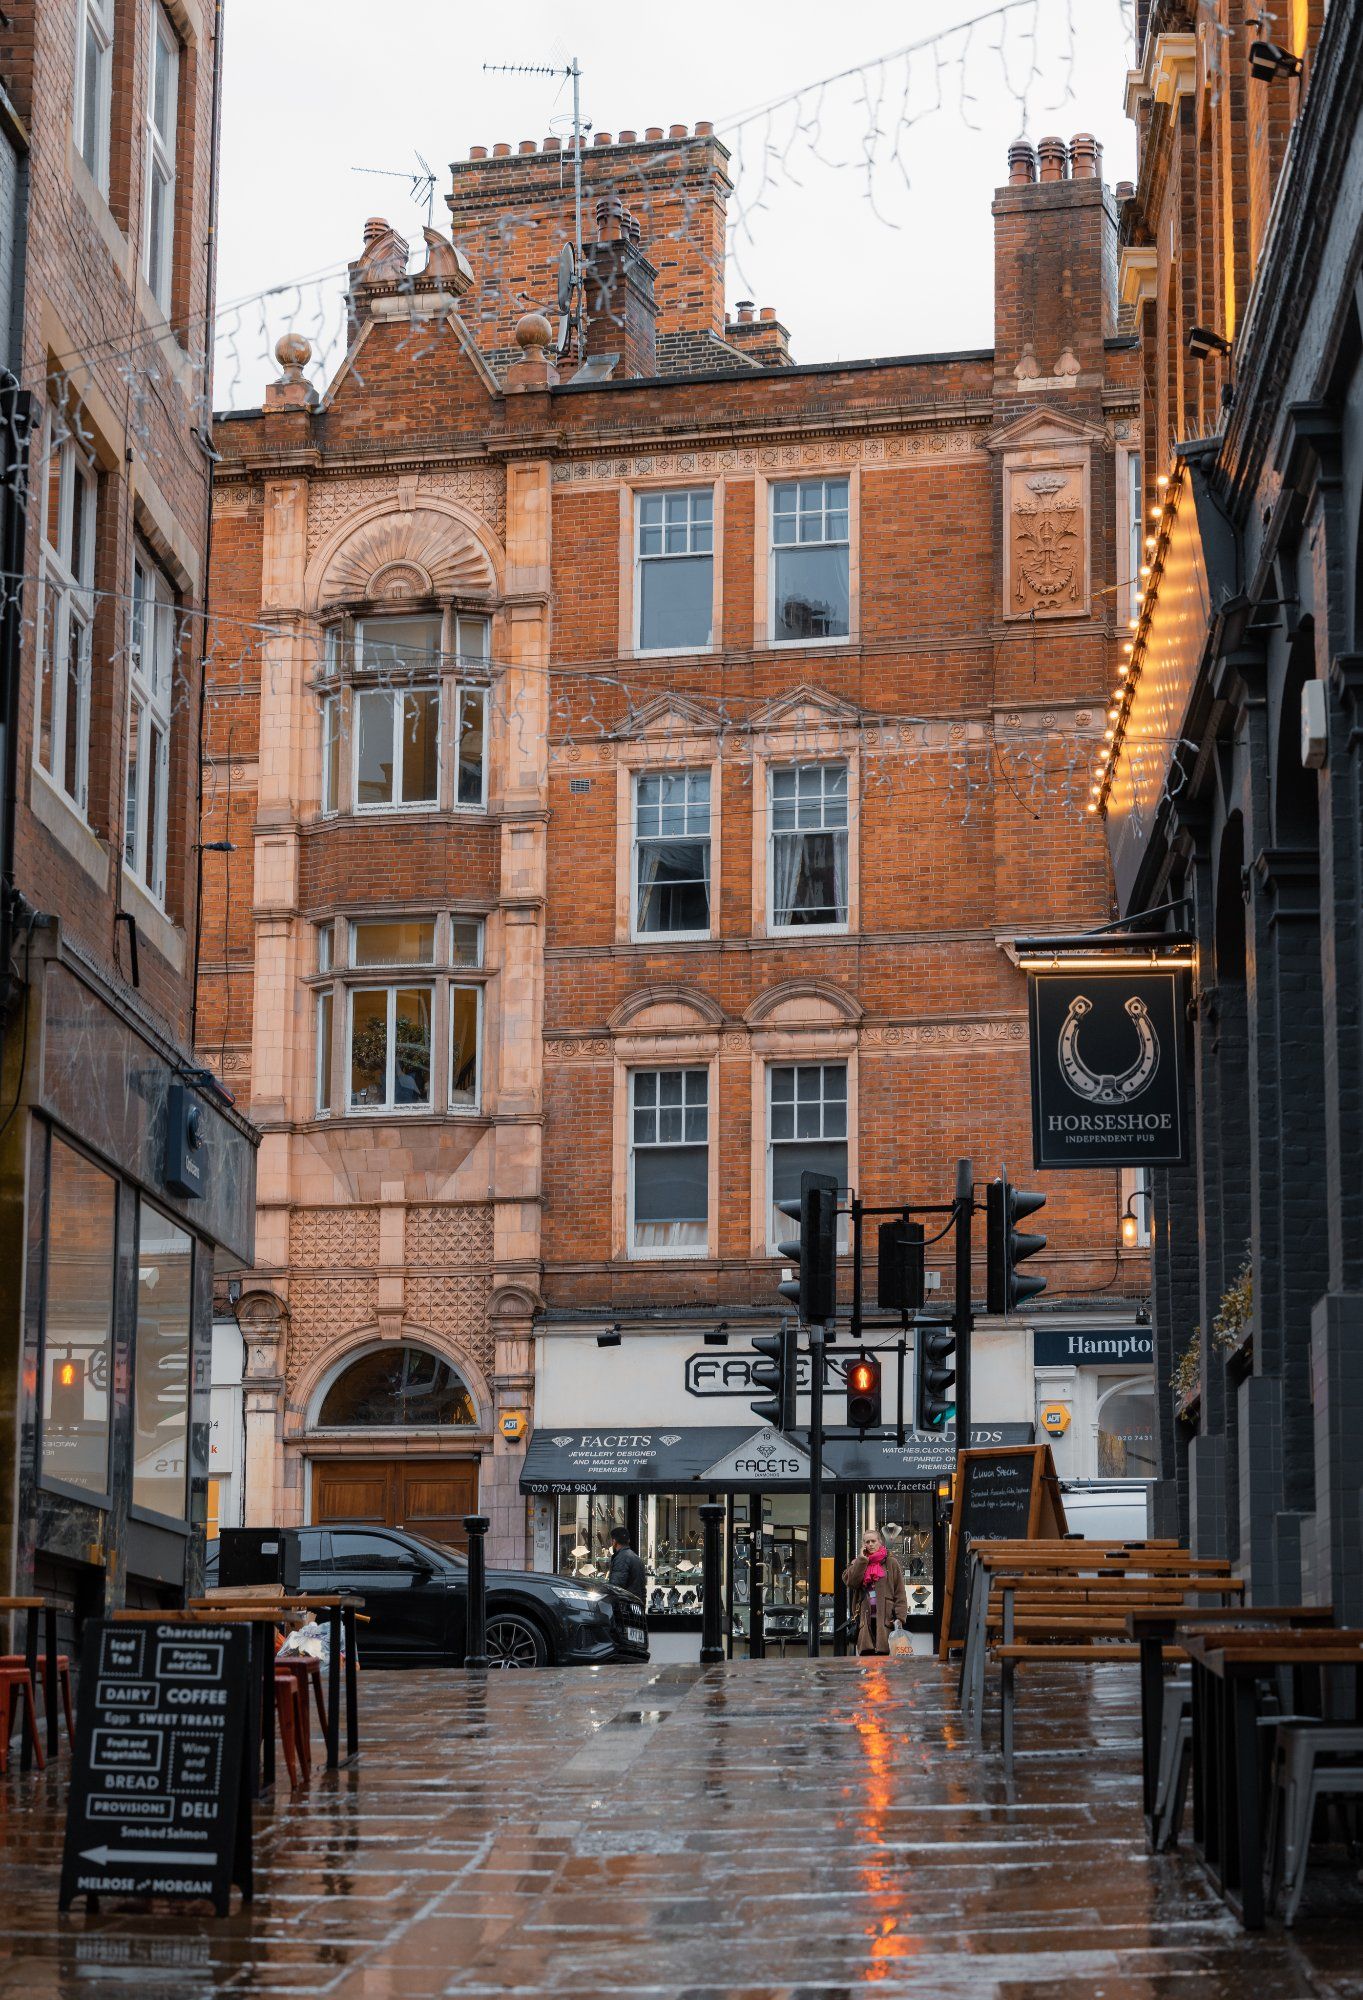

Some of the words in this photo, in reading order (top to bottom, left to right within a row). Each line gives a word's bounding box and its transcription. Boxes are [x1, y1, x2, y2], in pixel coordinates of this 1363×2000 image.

[1048, 1113, 1172, 1131] HORSESHOE
[1065, 1134, 1134, 1144] INDEPENDENT
[1136, 1134, 1155, 1142] PUB
[1067, 1336, 1154, 1358] Hampto
[504, 1420, 517, 1429] ADT
[579, 1435, 652, 1448] FACETS
[762, 1433, 771, 1441] 19
[568, 1450, 615, 1458] JEWELLERY
[735, 1459, 799, 1473] FACETS
[531, 1484, 549, 1493] 020
[551, 1484, 572, 1493] 7794
[576, 1483, 597, 1493] 9804
[156, 1625, 232, 1640] Charcuterie
[110, 1639, 136, 1651] Iced
[111, 1653, 133, 1664] Tea
[172, 1650, 208, 1661] Pastries
[167, 1660, 184, 1671] and
[106, 1687, 151, 1701] DAIRY
[166, 1687, 228, 1705] COFFEE
[104, 1711, 131, 1726] Eggs
[138, 1712, 179, 1726] SWEET
[180, 1713, 225, 1727] TREATS
[106, 1736, 129, 1749] Fruit
[129, 1738, 148, 1750] and
[181, 1742, 211, 1754] Wine
[101, 1749, 152, 1762] vegetables
[184, 1756, 206, 1768] and
[104, 1774, 160, 1790] BREAD
[180, 1770, 207, 1782] Beer
[93, 1801, 166, 1815] PROVISIONS
[180, 1801, 219, 1819] DELI
[120, 1825, 167, 1839] Smoked
[166, 1826, 209, 1840] Salmon
[77, 1876, 136, 1891] MELROSE
[152, 1879, 213, 1893] MORGAN
